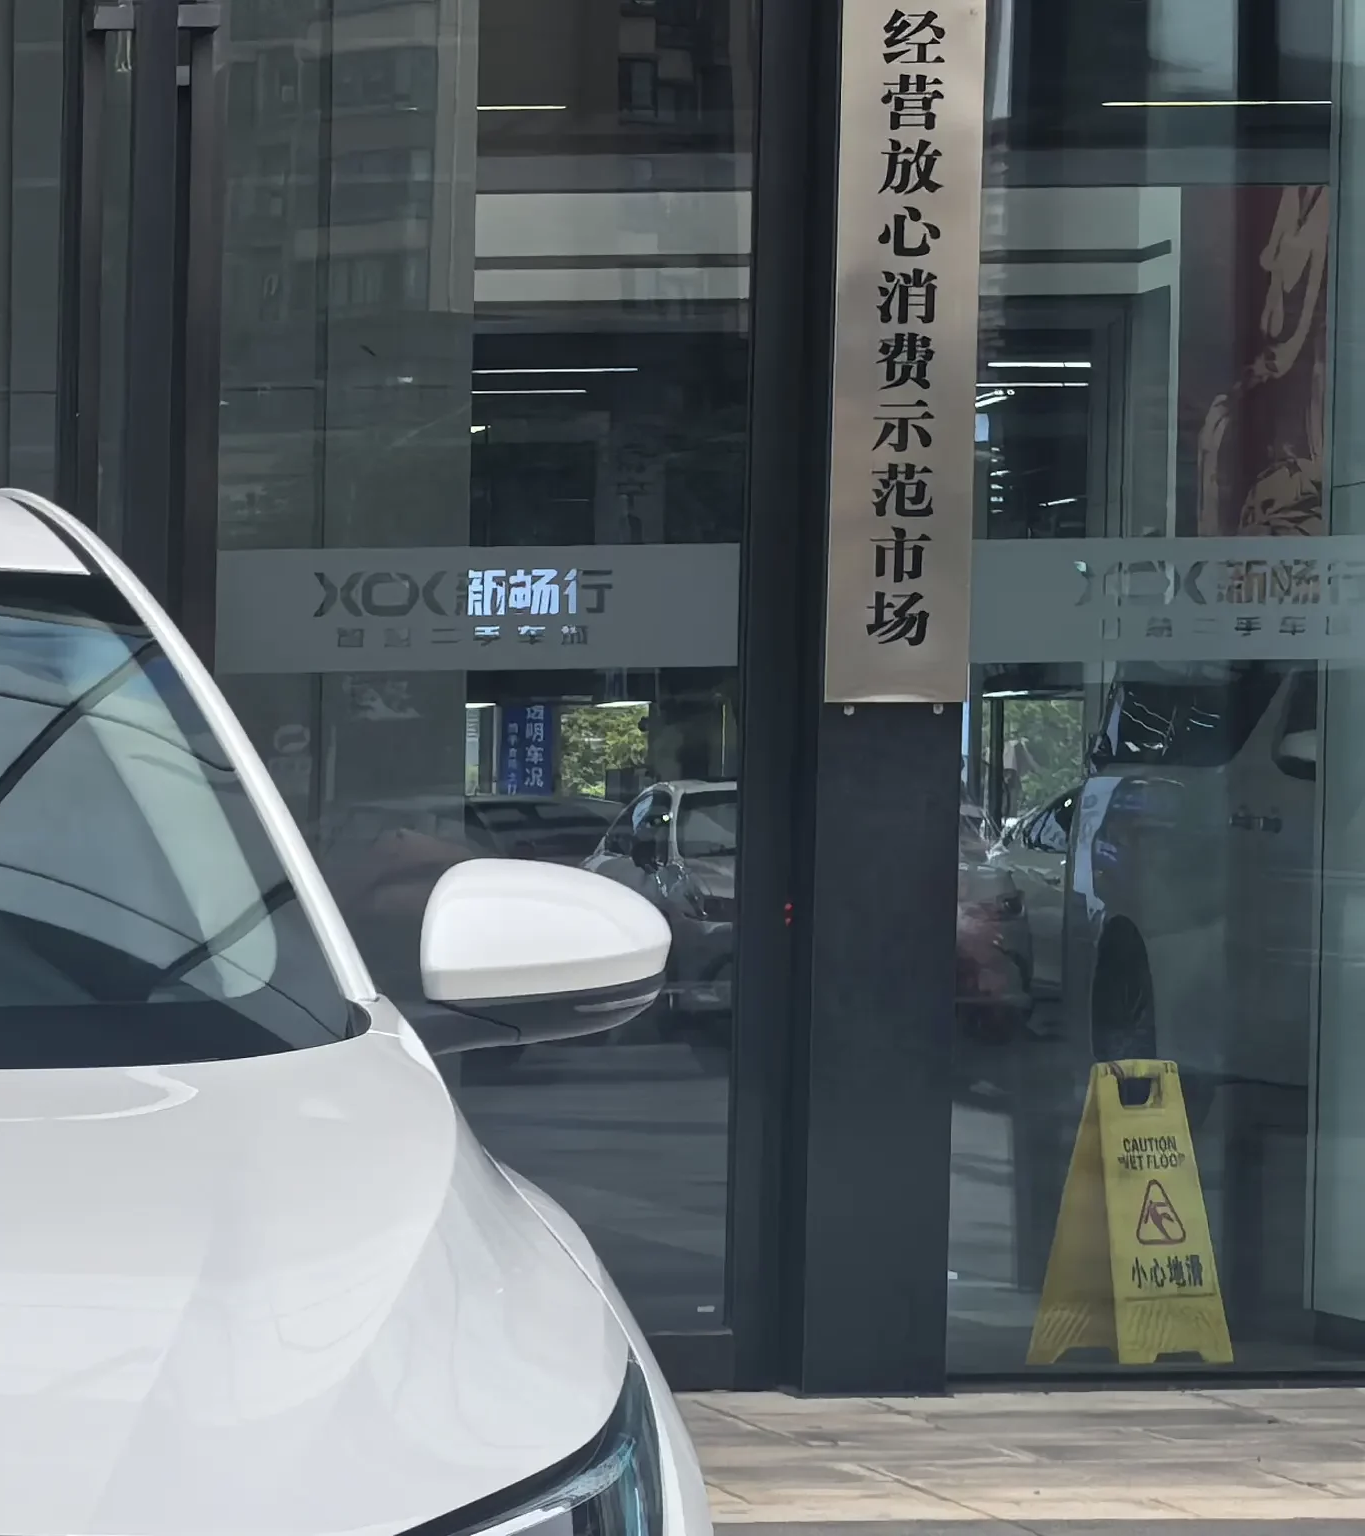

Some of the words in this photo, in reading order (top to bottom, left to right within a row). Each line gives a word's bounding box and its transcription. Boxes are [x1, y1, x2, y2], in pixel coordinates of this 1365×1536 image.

[866, 9, 945, 647] 经营放心消费示范市场
[454, 568, 613, 616] 新畅行
[1123, 1136, 1178, 1153] CAUTION
